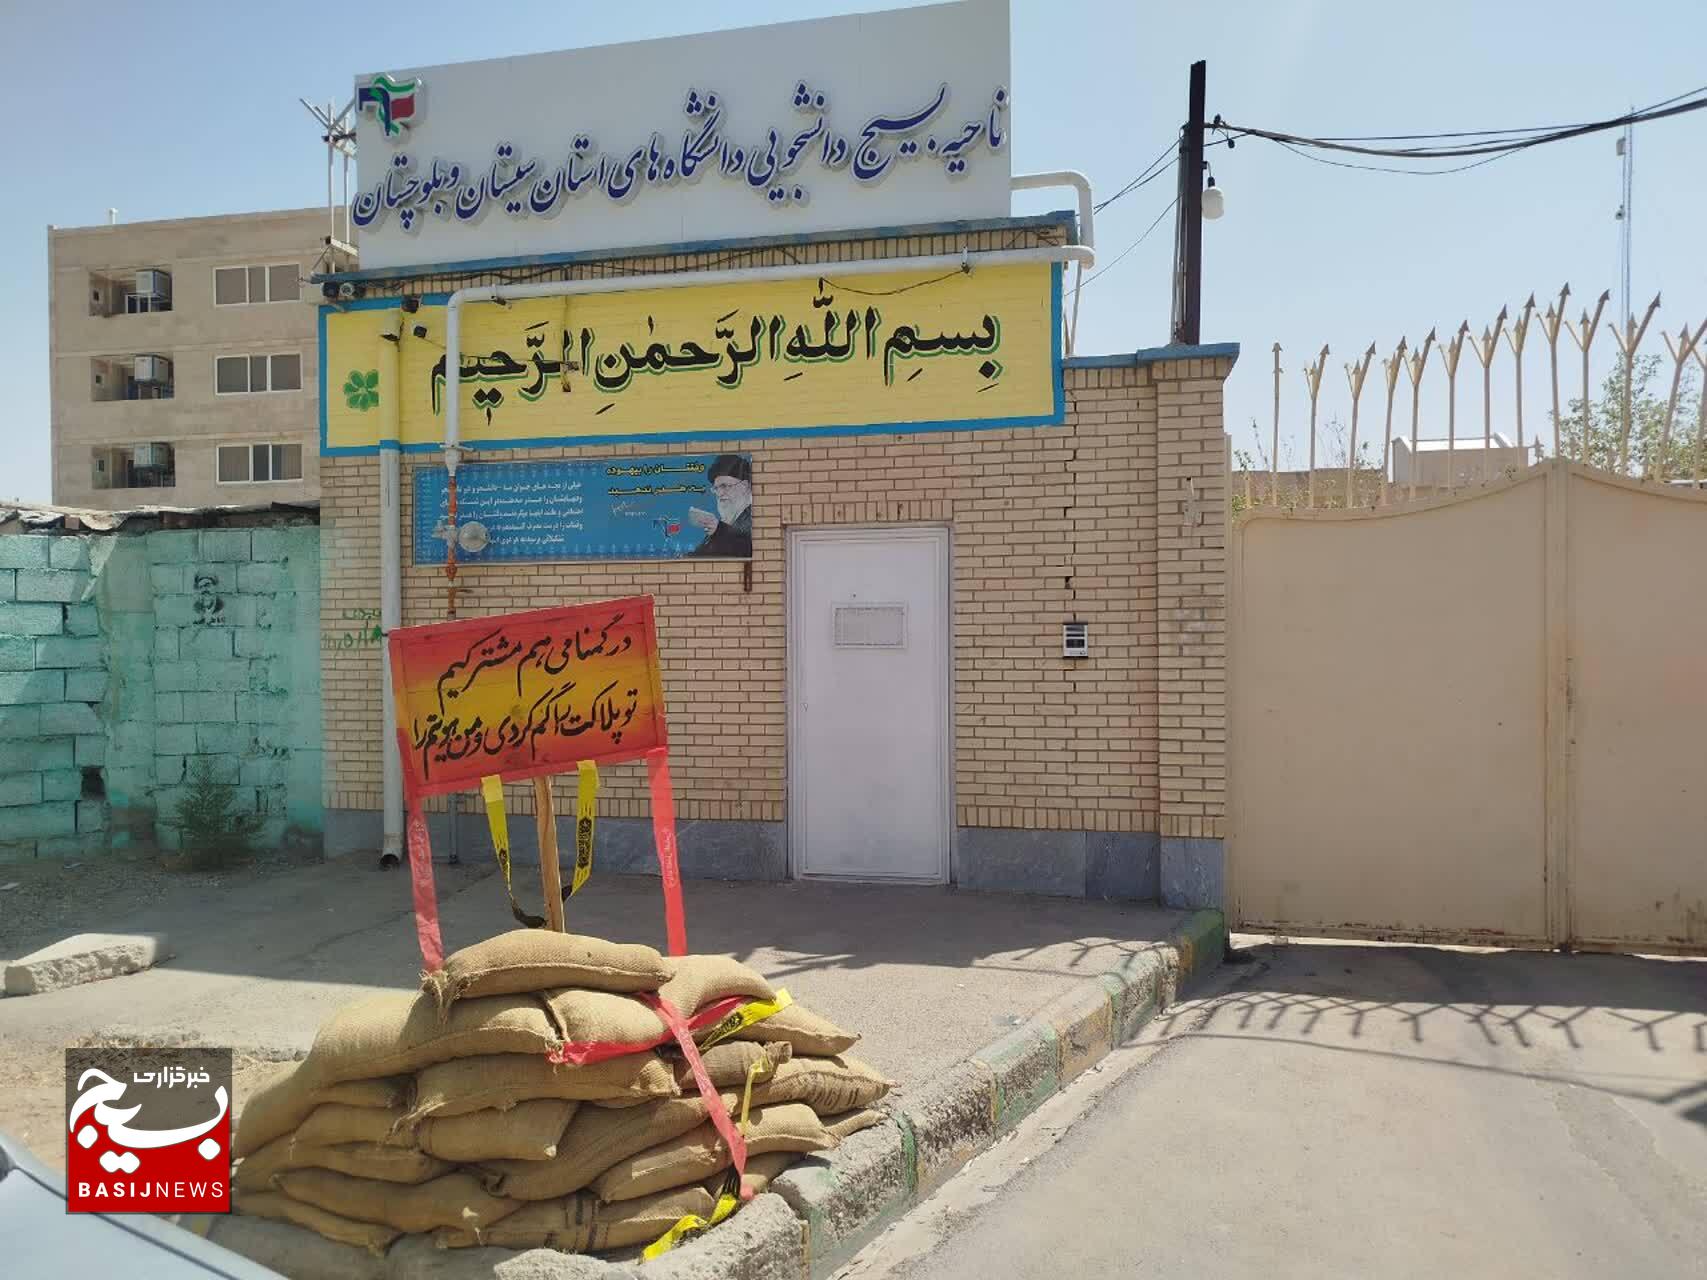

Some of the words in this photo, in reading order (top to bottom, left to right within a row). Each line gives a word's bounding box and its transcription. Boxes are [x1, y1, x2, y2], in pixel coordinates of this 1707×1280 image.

[747, 83, 848, 200] دانشجویی
[853, 82, 946, 180] بسیج
[941, 87, 1004, 172] ناحیه
[455, 144, 536, 219] سیستان
[530, 137, 605, 213] استان
[606, 635, 632, 657] در
[620, 688, 638, 728] تو
